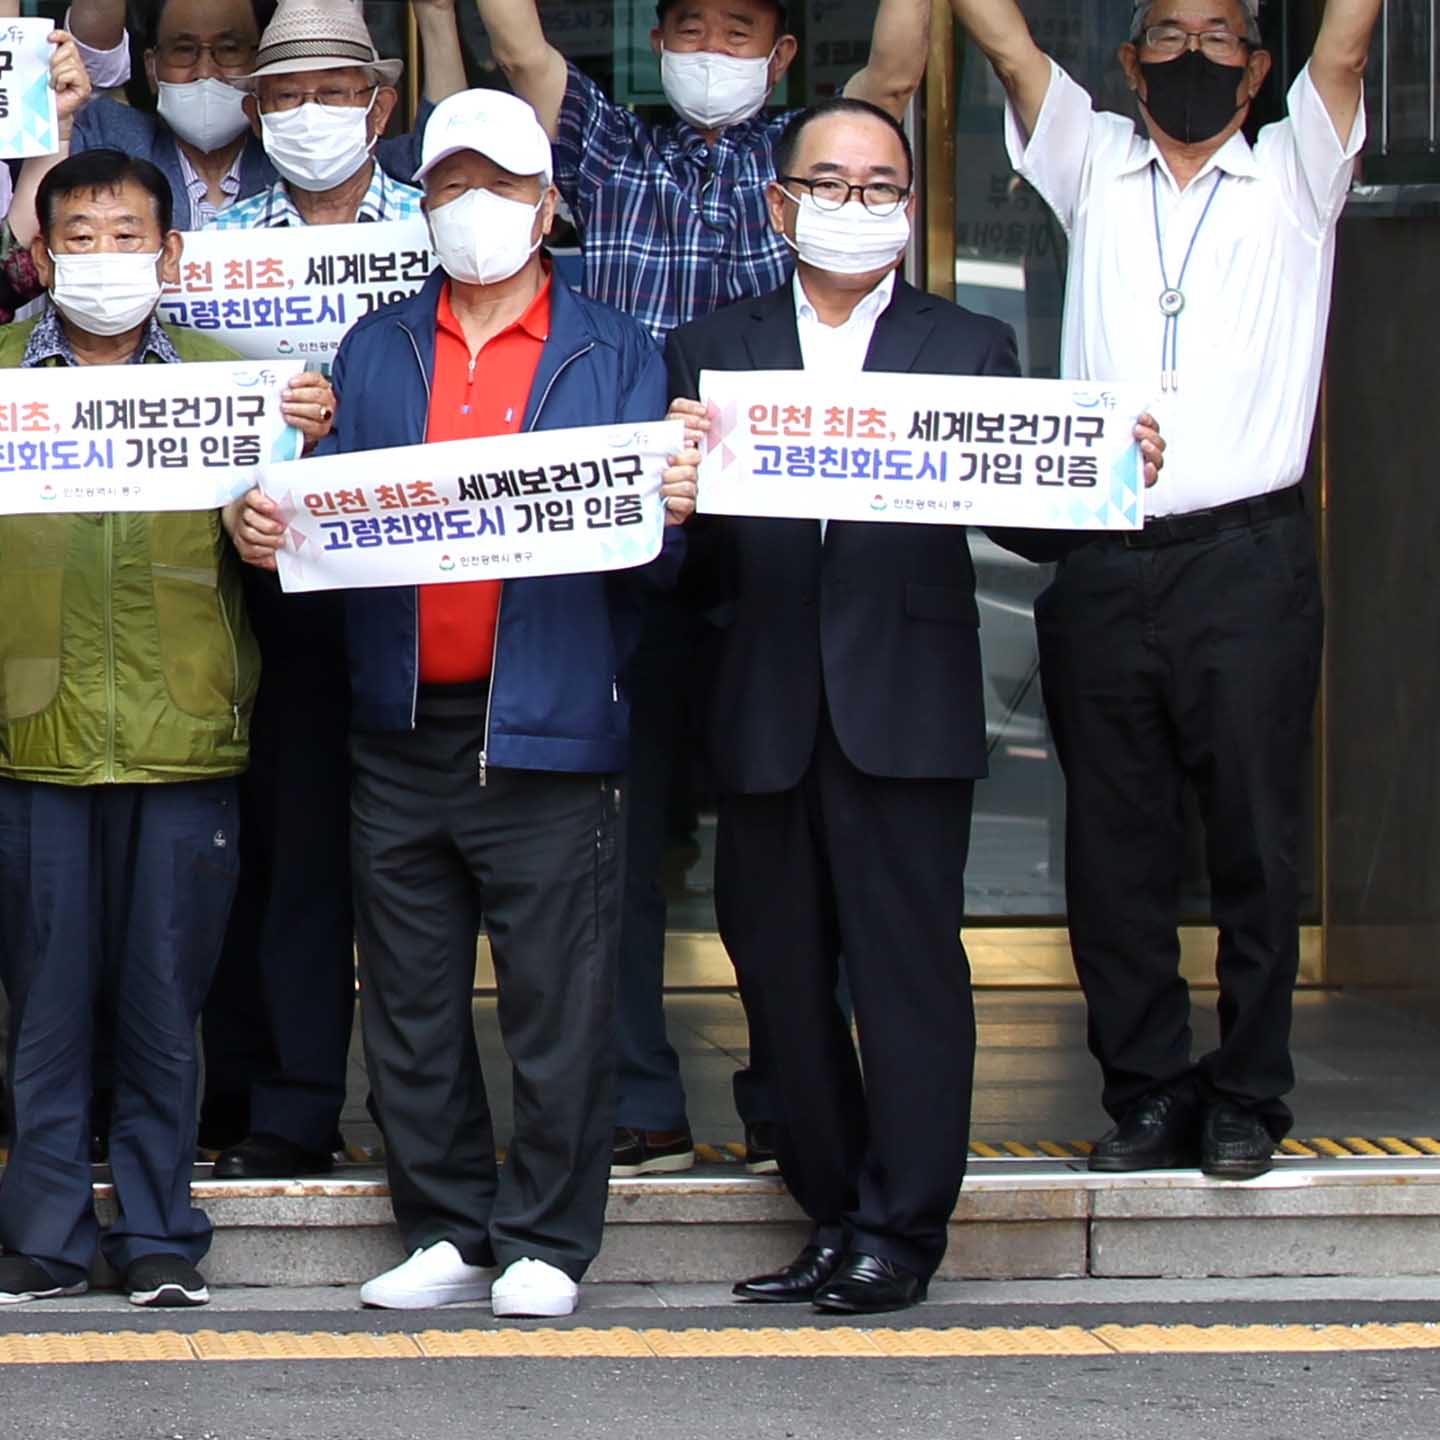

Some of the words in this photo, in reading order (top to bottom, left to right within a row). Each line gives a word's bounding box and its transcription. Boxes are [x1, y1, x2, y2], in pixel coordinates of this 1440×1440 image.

[72, 396, 265, 430] 세계보건기구
[748, 405, 812, 436] 인천
[824, 406, 896, 440] 최초,
[908, 410, 1104, 447] 세계보건기구
[126, 437, 188, 468] 가입
[200, 435, 261, 467] 인증
[753, 445, 947, 482] 고령친화도시
[960, 453, 1022, 485] 가입
[1035, 455, 1098, 487] 인증
[304, 488, 371, 517] 인천
[372, 480, 451, 510] 최초,
[458, 455, 643, 501] 세계보건기구
[320, 508, 504, 550] 고령친화도시
[515, 501, 574, 536] 가입
[585, 494, 643, 528] 인증
